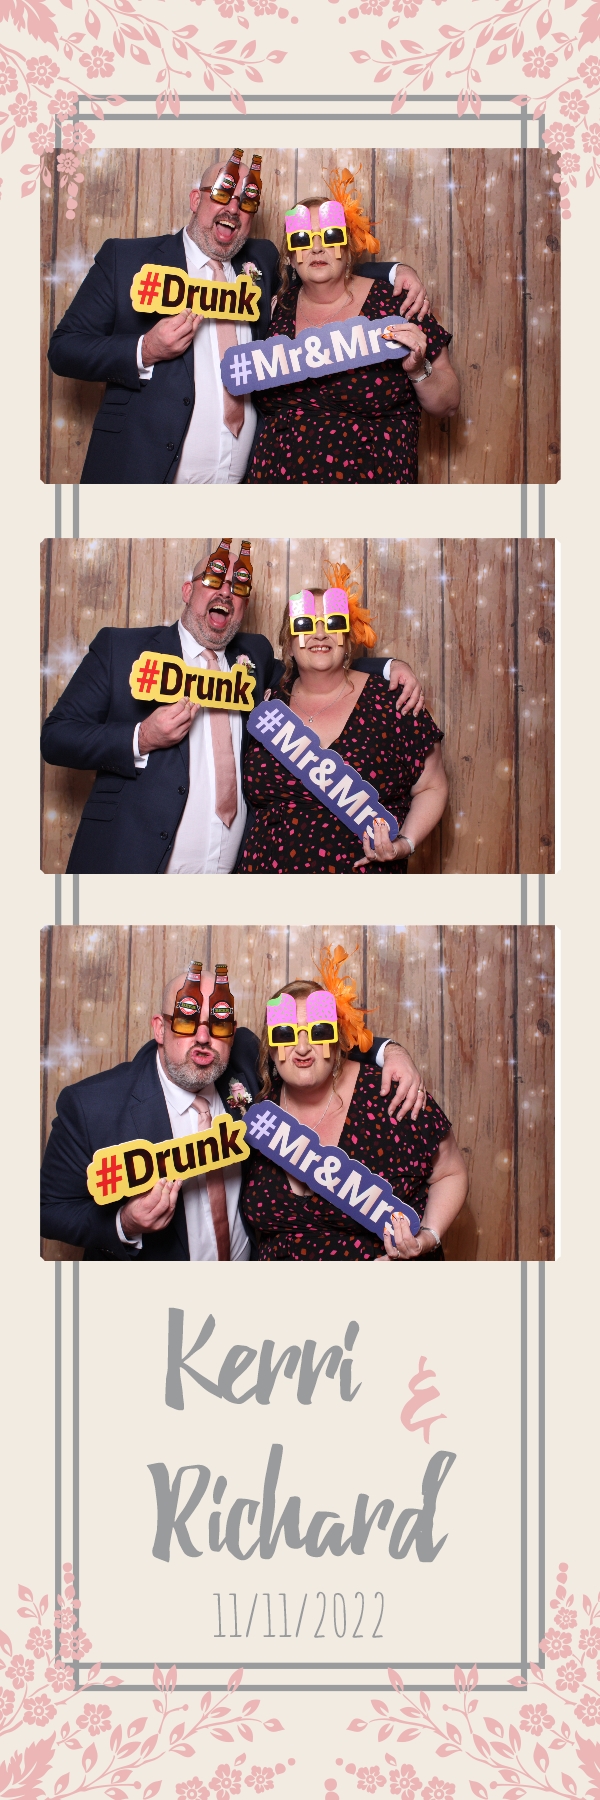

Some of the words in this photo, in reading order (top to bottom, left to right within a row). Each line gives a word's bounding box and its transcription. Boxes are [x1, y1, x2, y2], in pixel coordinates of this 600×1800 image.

[137, 271, 257, 316] #Drunk
[136, 658, 251, 705] #Drunk
[96, 1122, 241, 1197] #Drunk
